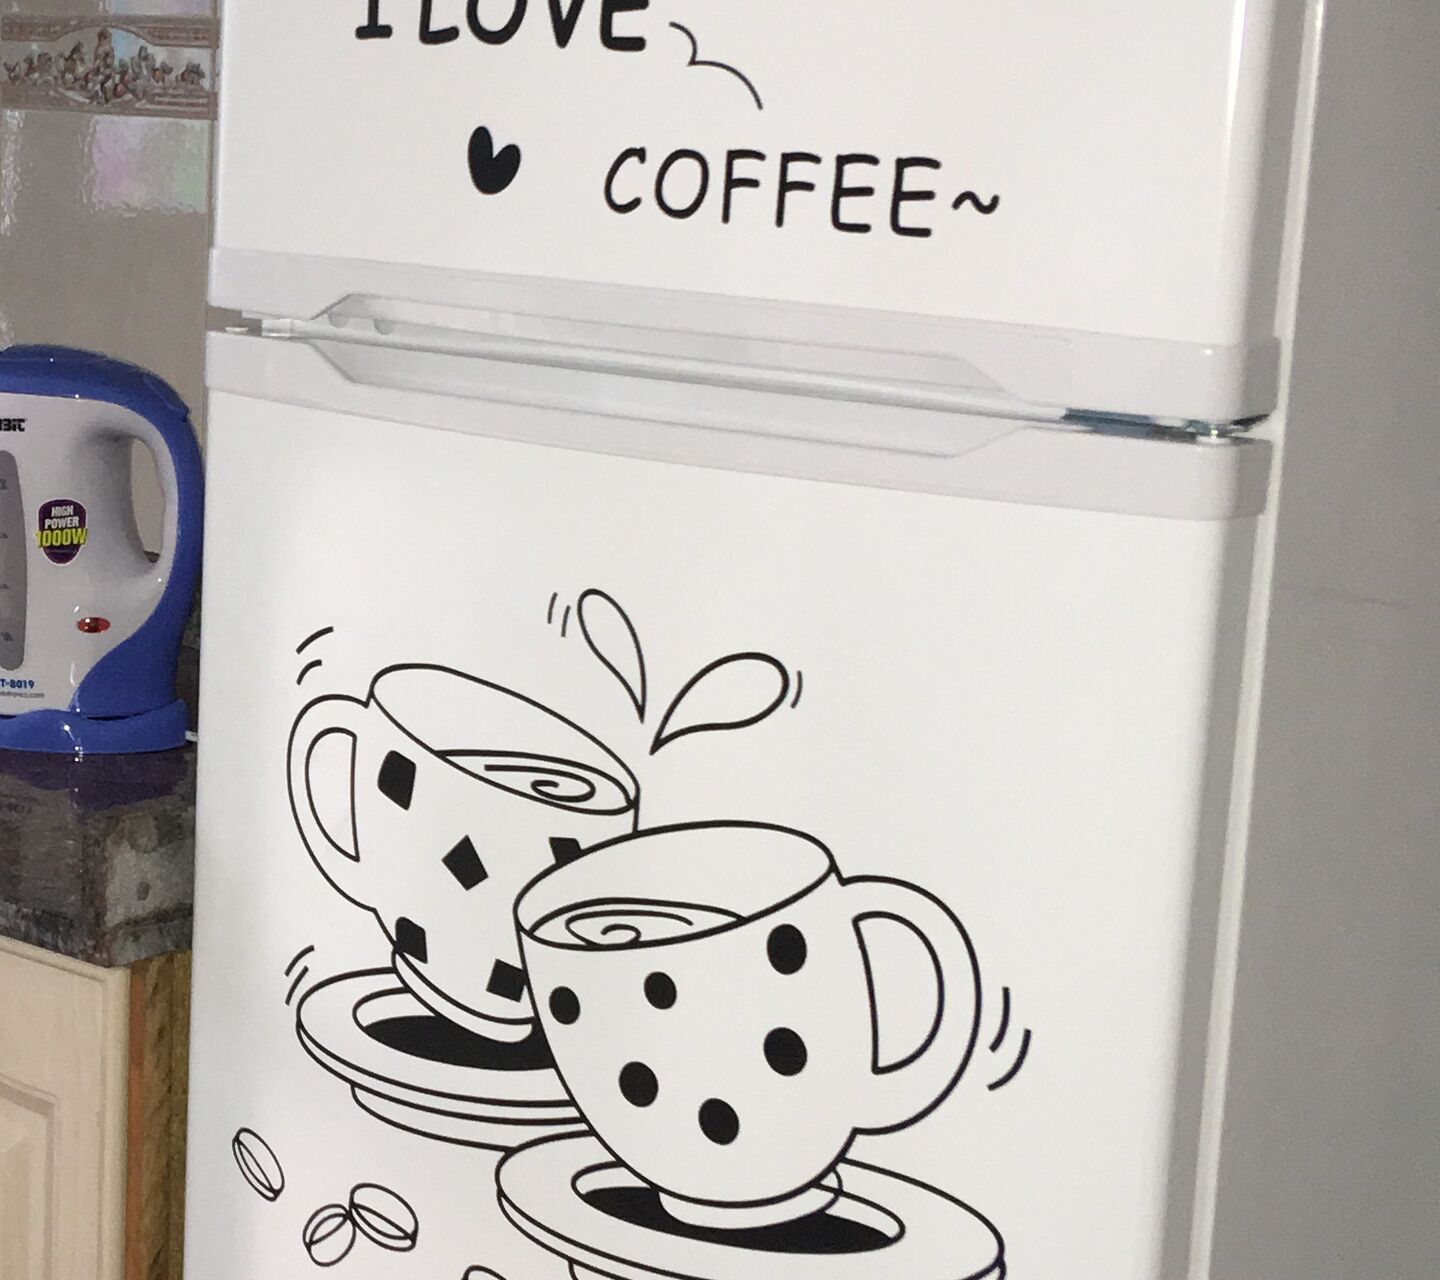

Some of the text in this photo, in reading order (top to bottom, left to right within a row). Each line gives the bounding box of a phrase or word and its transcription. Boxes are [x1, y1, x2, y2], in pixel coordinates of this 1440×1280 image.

[51, 505, 74, 517] HIGH
[44, 516, 80, 529] POWER
[35, 528, 88, 548] 1000W
